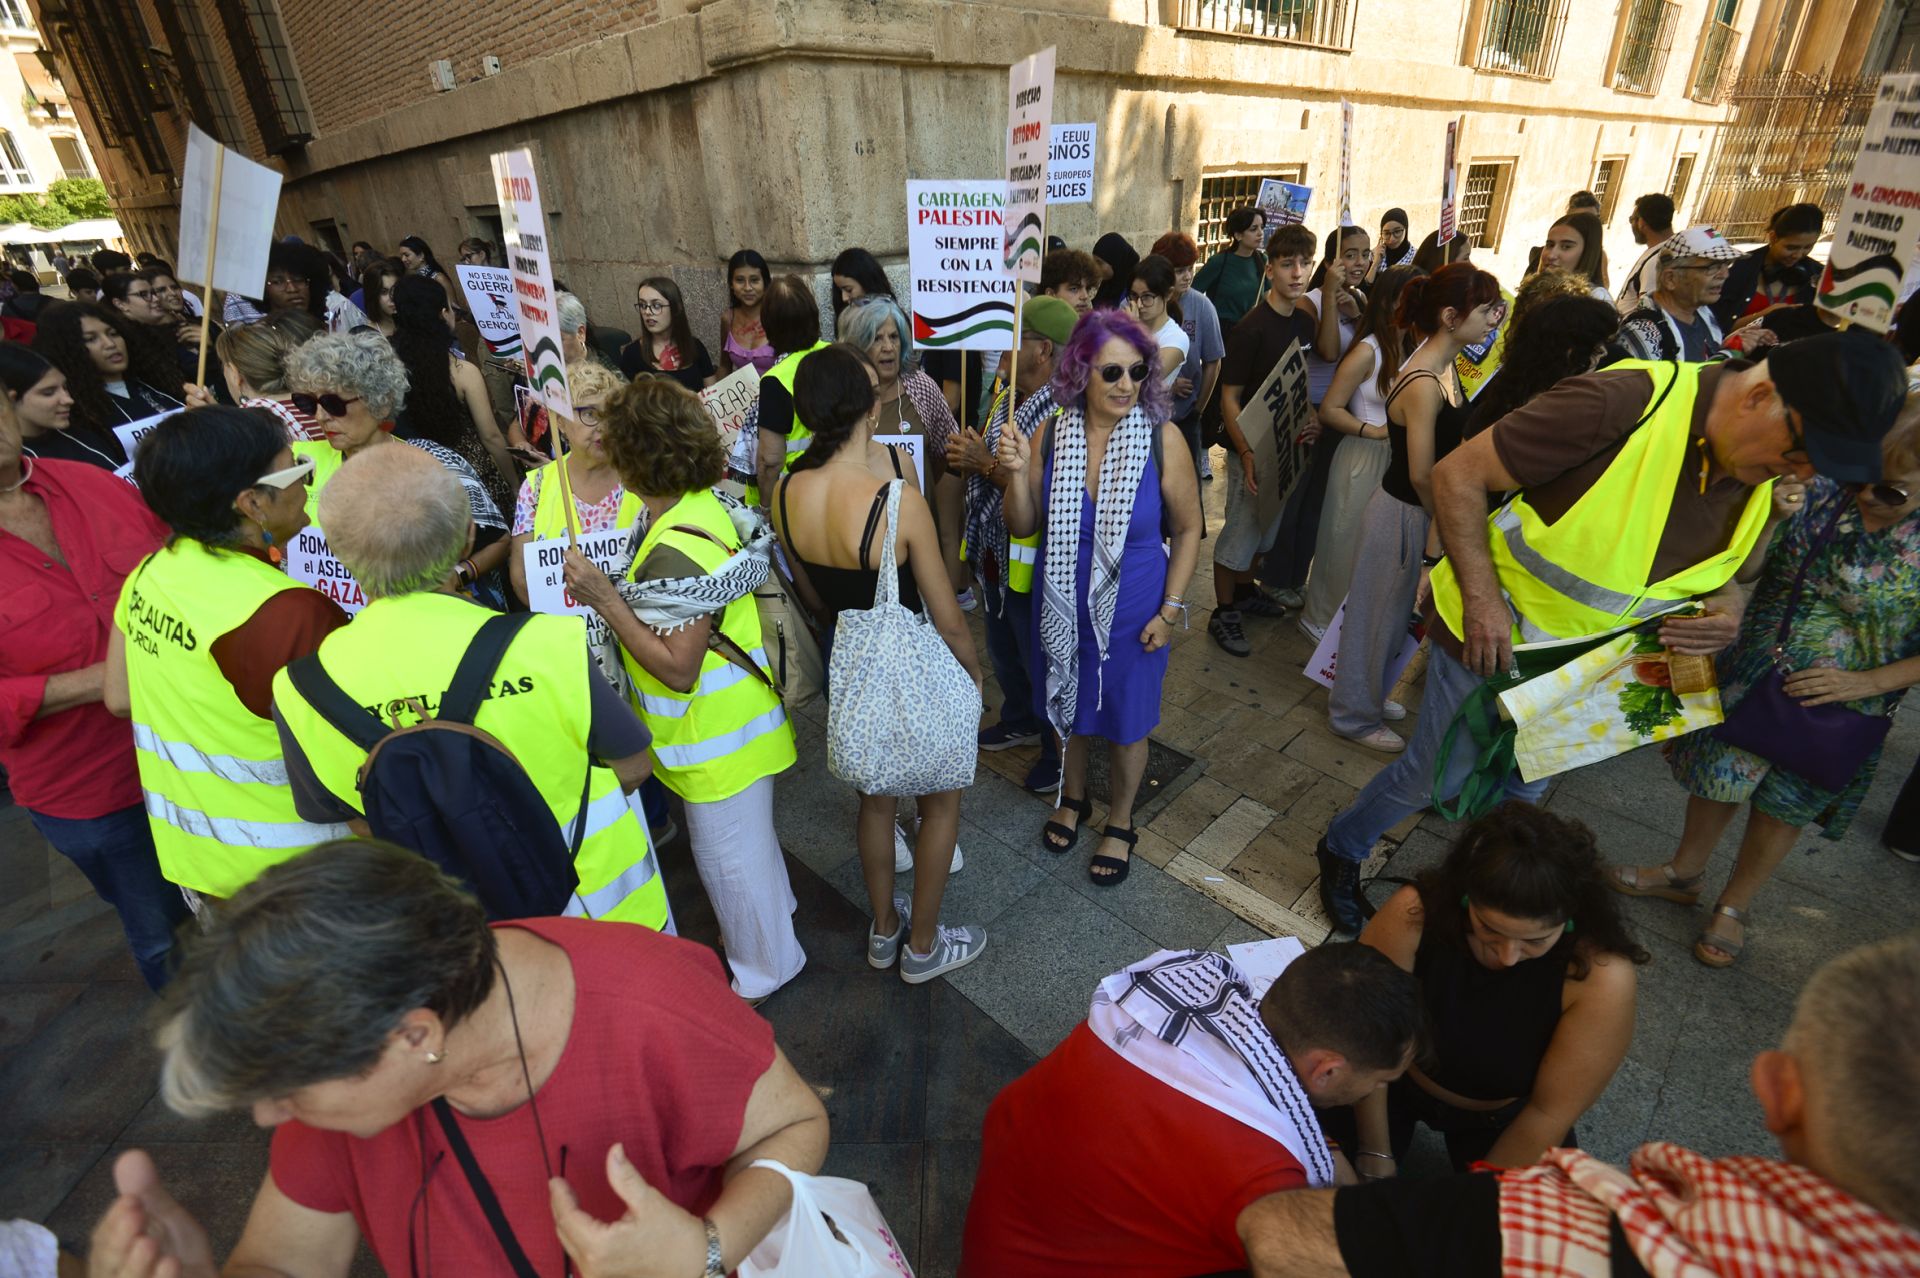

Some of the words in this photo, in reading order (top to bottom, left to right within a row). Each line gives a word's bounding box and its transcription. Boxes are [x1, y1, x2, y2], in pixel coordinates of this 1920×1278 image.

[1012, 121, 1041, 145] RETORNO
[1062, 130, 1090, 143] EEUU
[1053, 169, 1092, 181] EUROPEOS
[917, 208, 1005, 226] PALESTIN
[1864, 209, 1903, 233] PUEBLO
[934, 236, 1000, 251] SIEMPRE
[1846, 230, 1897, 257] PALESTINO
[940, 258, 971, 272] CON
[975, 258, 993, 272] LA
[482, 272, 493, 280] ES
[493, 273, 510, 282] UNA
[917, 279, 1017, 294] RESISTENCIA
[538, 537, 628, 568] ROAMO
[304, 560, 314, 574] el
[317, 559, 356, 581] ASED
[546, 572, 558, 586] el
